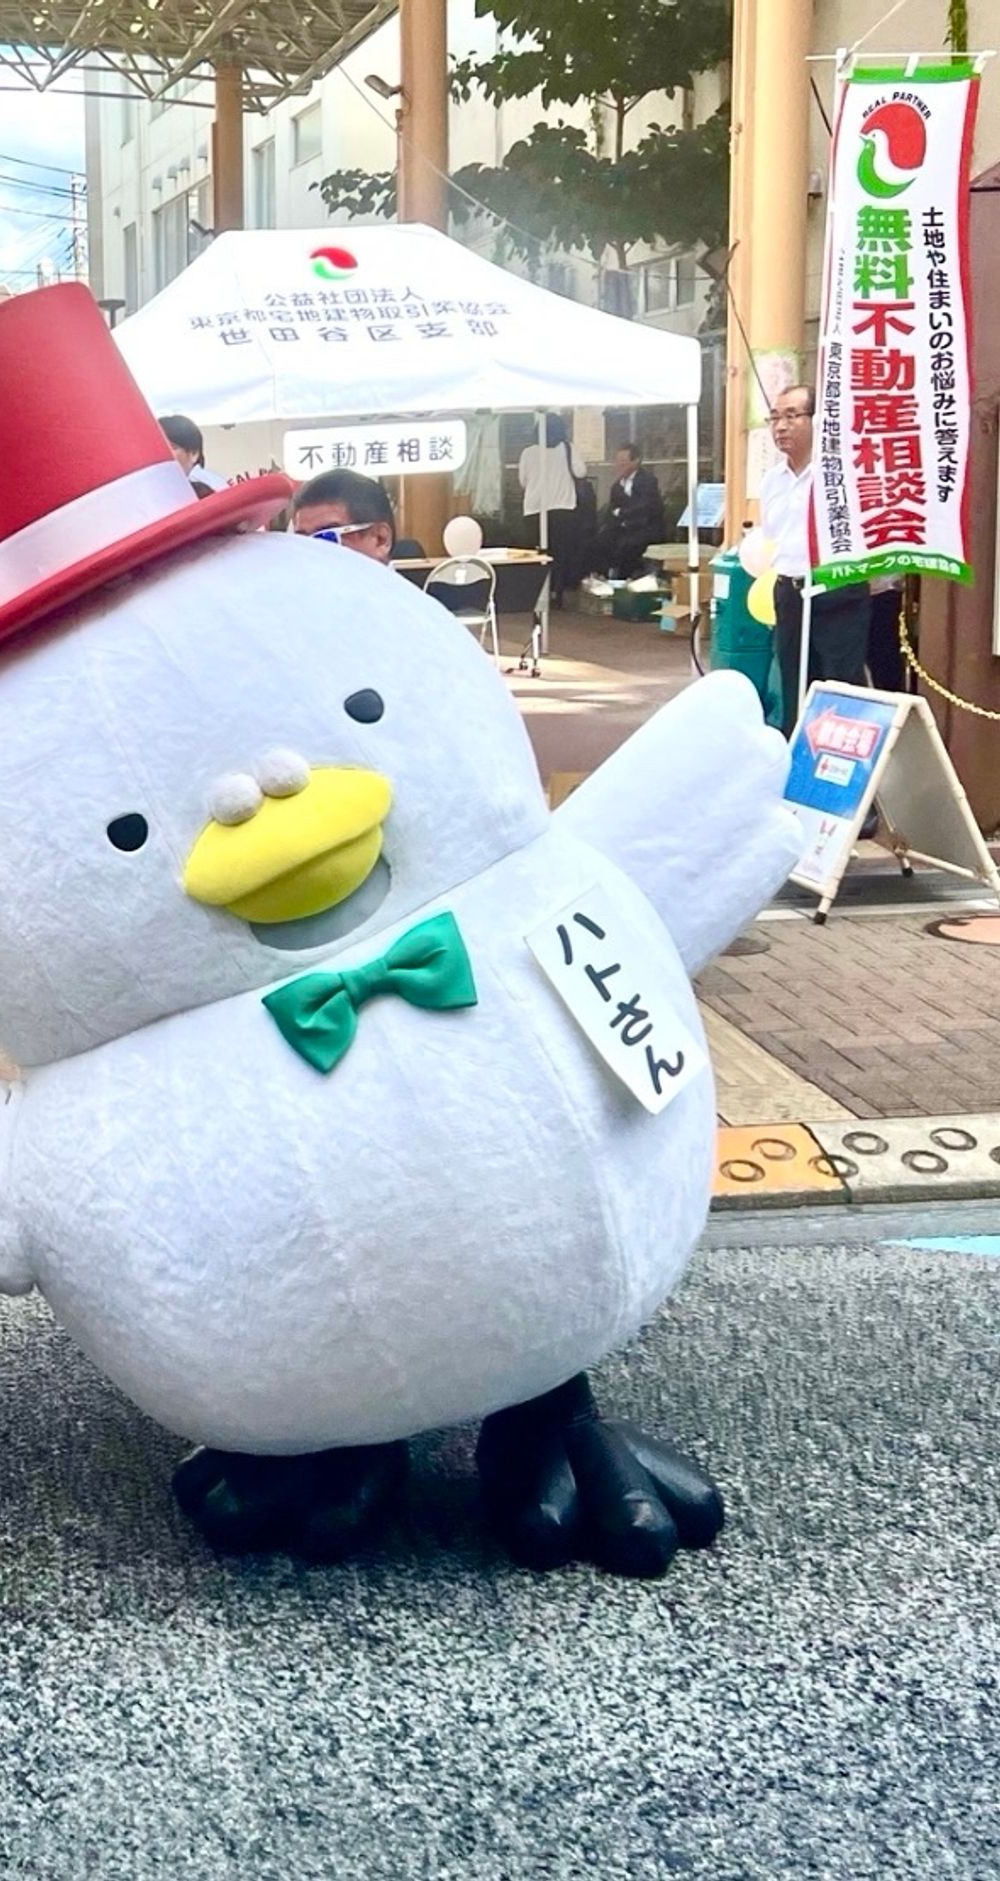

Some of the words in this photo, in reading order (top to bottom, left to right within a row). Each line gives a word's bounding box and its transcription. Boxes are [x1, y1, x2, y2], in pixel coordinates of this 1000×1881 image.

[218, 319, 500, 346] 世田谷区支部
[263, 286, 425, 307] 公益社団法人
[849, 204, 927, 549] 無料不動産相談会
[921, 206, 958, 503] 土地や住まいのお悩みに答えます
[298, 436, 455, 469] 不動産相談
[821, 341, 853, 554] 東京都宅地建物取引業協会
[556, 911, 685, 1096] ハトさん
